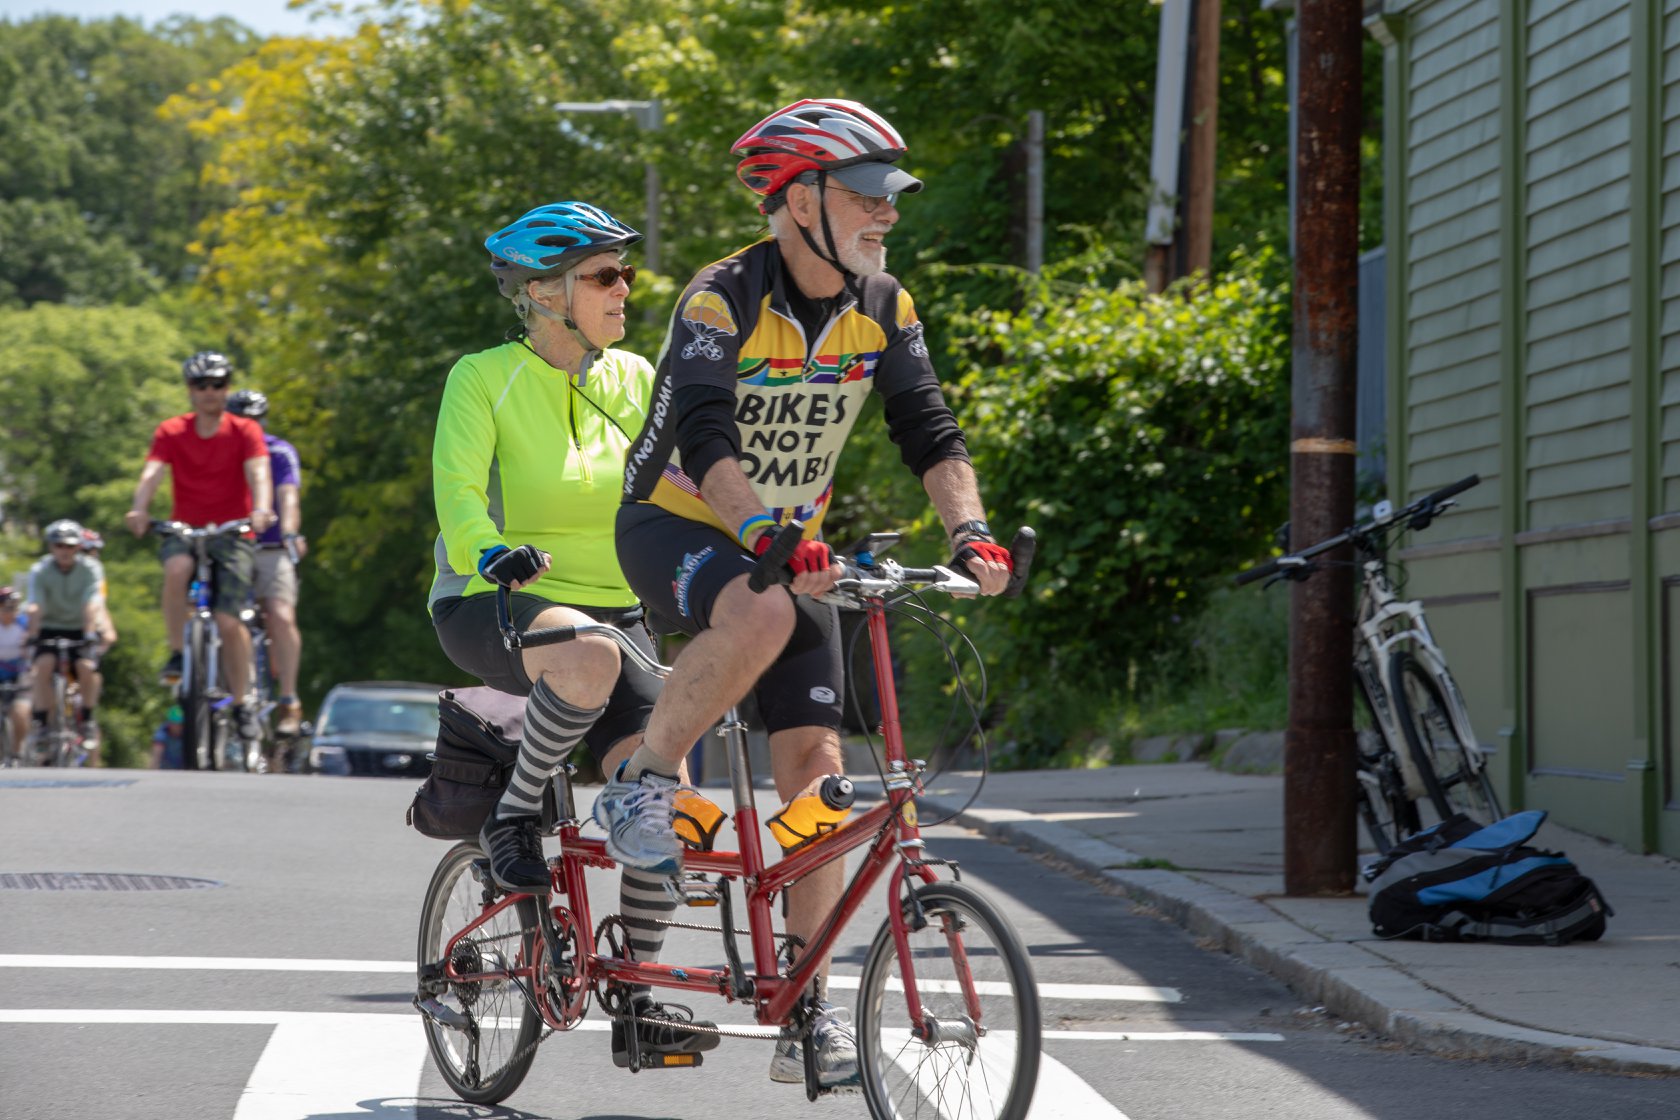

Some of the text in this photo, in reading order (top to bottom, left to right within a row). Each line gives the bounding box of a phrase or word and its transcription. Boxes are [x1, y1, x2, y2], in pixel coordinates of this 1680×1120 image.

[503, 246, 534, 264] Giro
[735, 392, 849, 427] BIKES
[633, 426, 658, 466] NOT
[747, 429, 824, 454] NOT
[738, 450, 835, 487] OMBS
